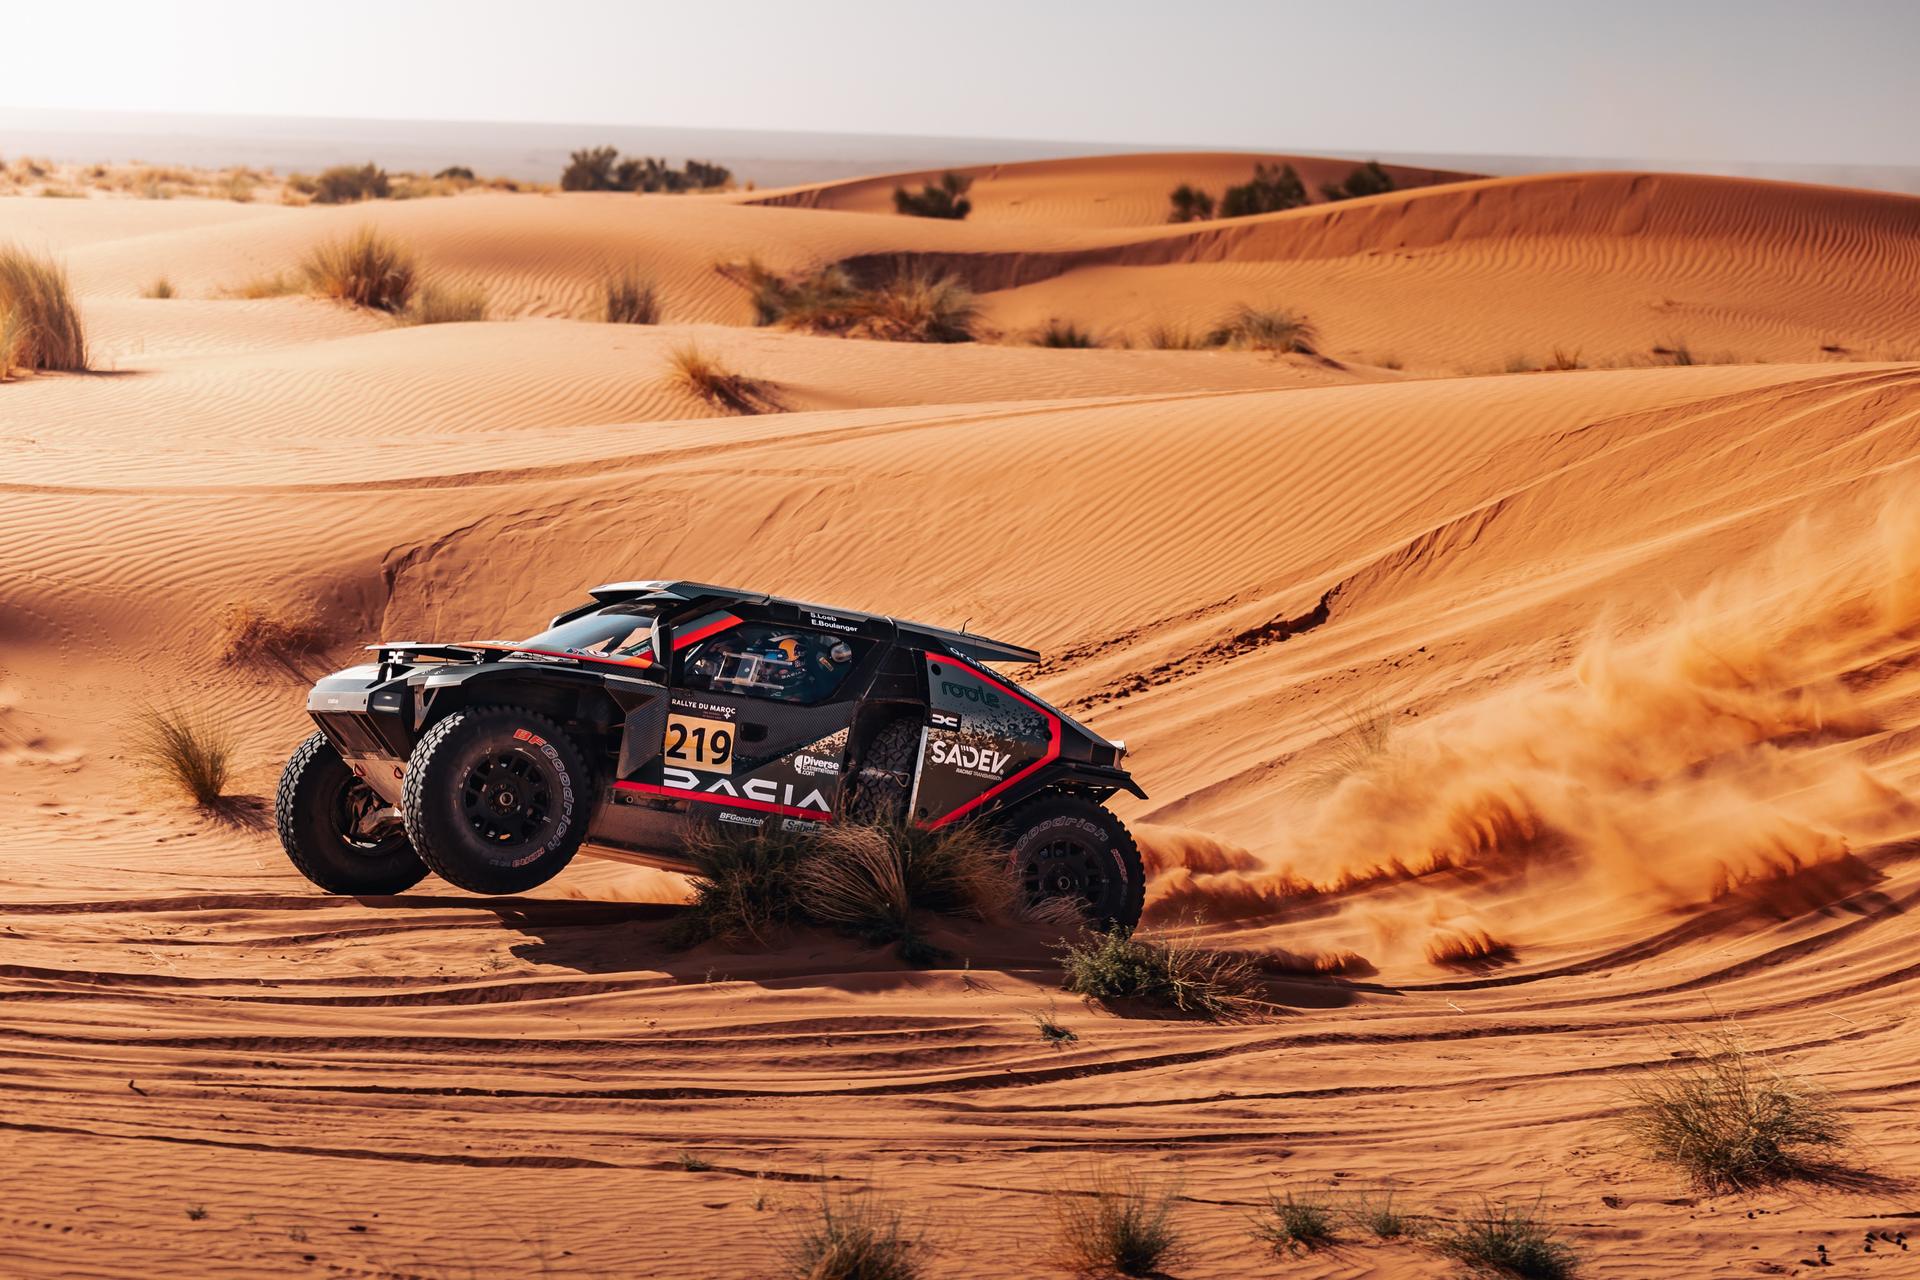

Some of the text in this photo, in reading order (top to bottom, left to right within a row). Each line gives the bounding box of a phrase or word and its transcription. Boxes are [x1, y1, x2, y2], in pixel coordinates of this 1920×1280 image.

[811, 619, 858, 632] E.Boulanger
[671, 698, 697, 709] RALLYE
[710, 704, 736, 715] MAROC
[666, 723, 731, 765] 219
[803, 755, 840, 770] Diverse
[931, 740, 1012, 774] SADEV
[956, 767, 973, 776] RACING
[512, 727, 575, 851] BFGoodrich
[663, 767, 832, 812] DACIA
[719, 811, 765, 825] BFGoodrich
